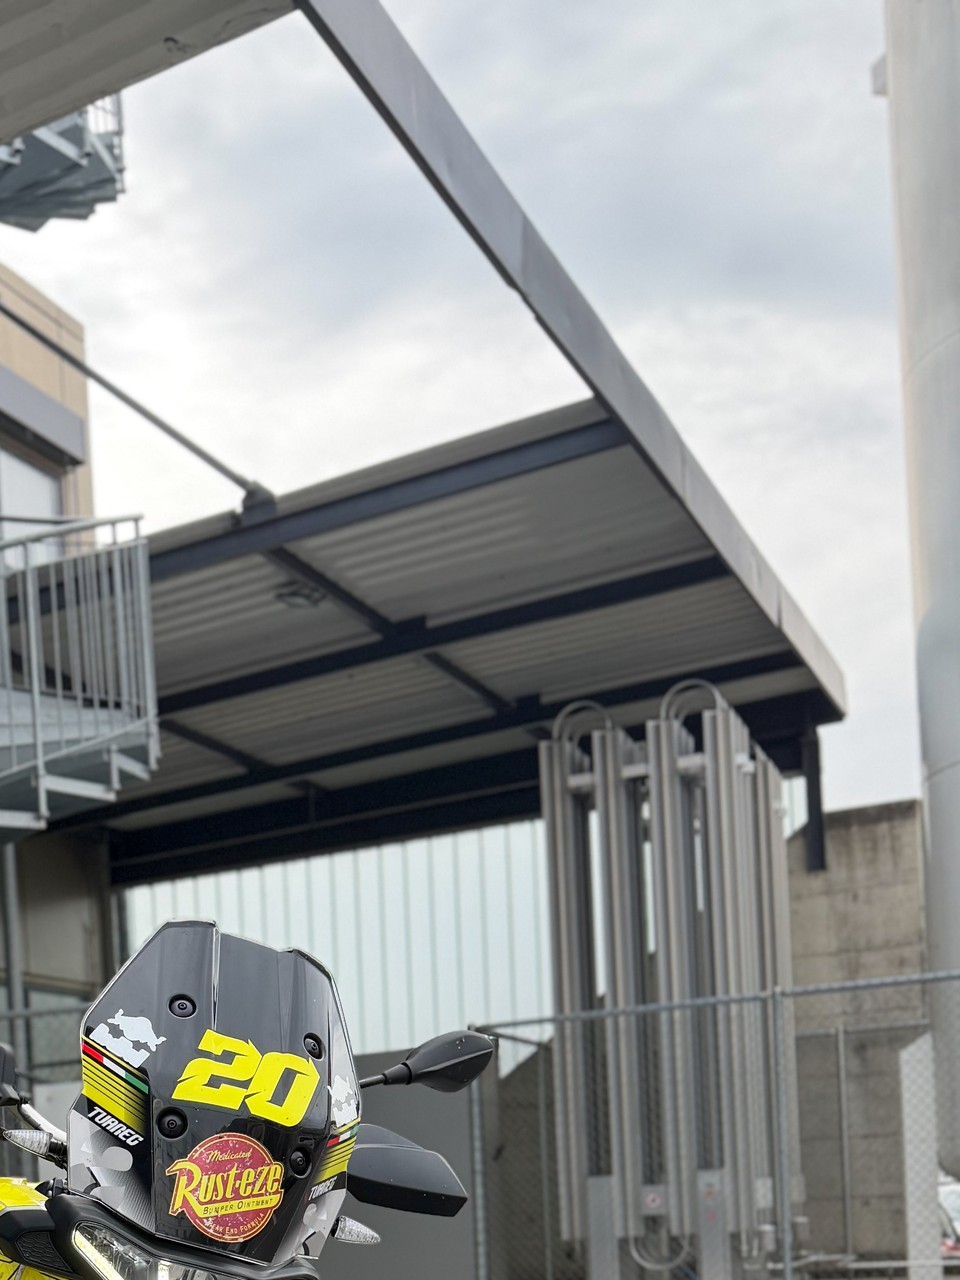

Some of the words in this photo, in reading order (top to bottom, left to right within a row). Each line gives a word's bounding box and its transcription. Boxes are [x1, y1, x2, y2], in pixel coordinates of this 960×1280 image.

[171, 1029, 321, 1127] 20
[88, 1106, 144, 1147] TUAREG
[206, 1148, 253, 1163] Medicated
[202, 1204, 234, 1216] BUMPER
[237, 1198, 274, 1210] OINTMENT
